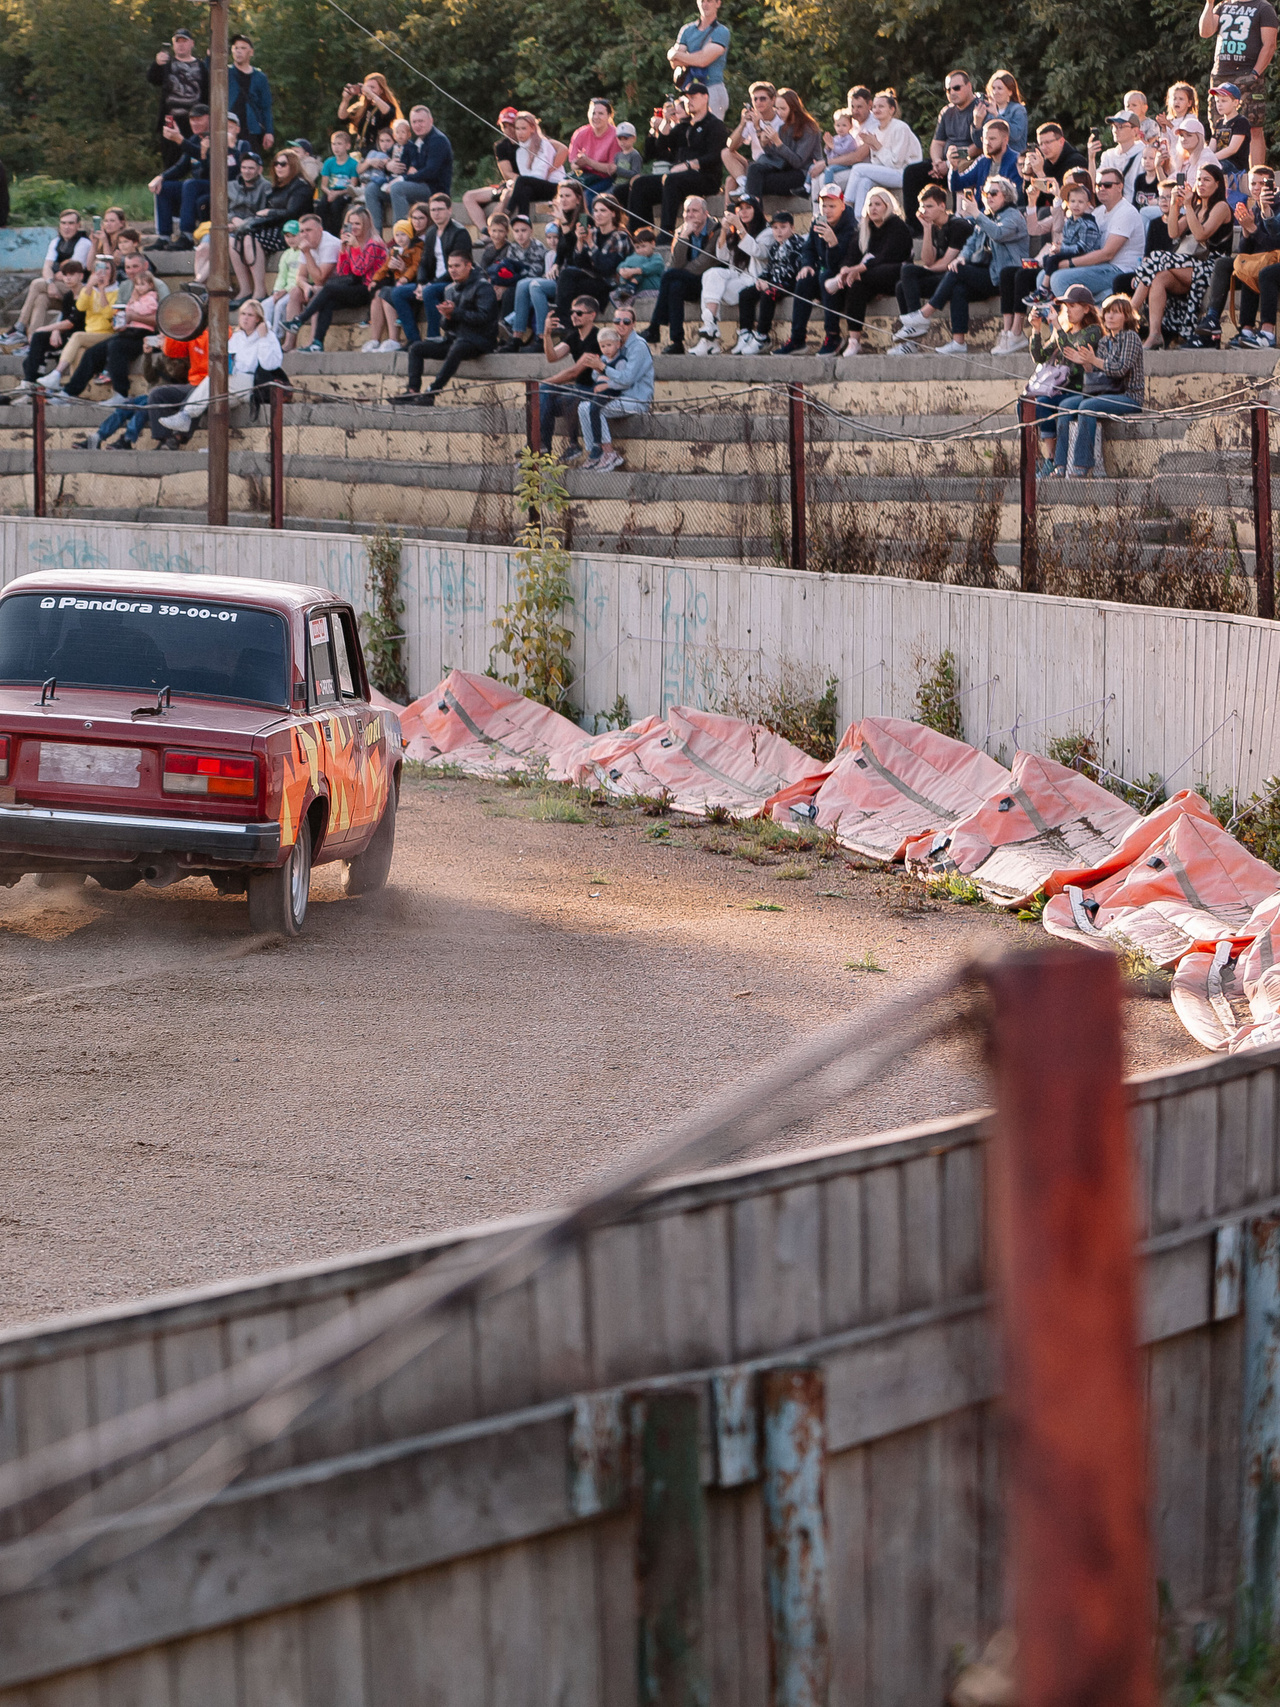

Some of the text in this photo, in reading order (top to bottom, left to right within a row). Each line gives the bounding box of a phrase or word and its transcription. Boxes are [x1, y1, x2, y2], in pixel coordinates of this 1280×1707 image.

[1222, 4, 1257, 17] TEAM
[1219, 14, 1251, 41] 23
[1220, 40, 1247, 54] TOP
[58, 597, 238, 623] Pandora 39-00-01
